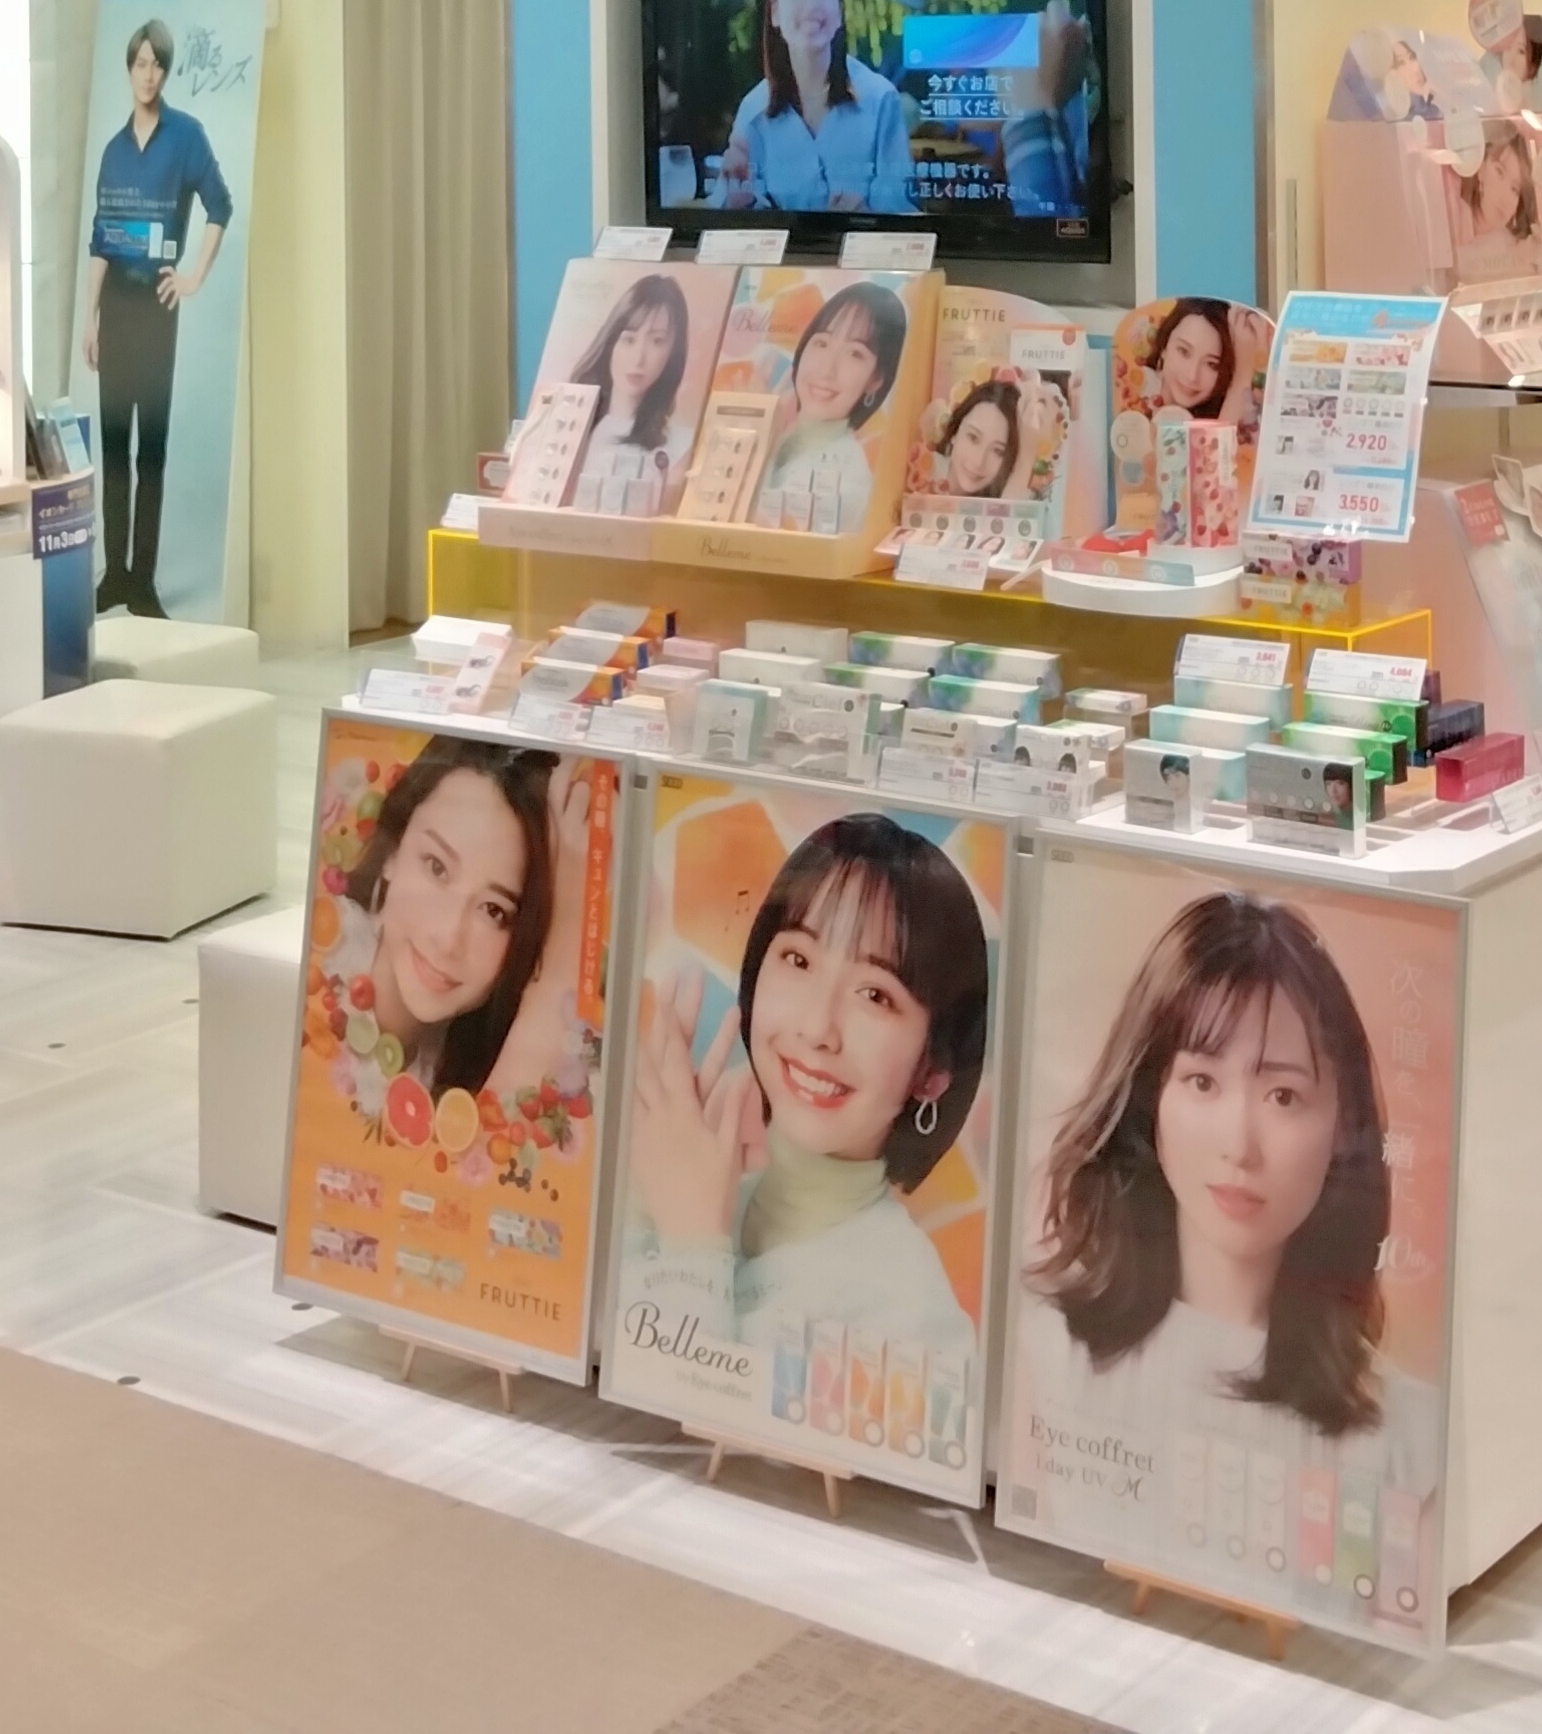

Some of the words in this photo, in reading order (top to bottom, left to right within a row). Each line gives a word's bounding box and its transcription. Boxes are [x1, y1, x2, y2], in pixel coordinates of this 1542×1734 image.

[927, 74, 1014, 93] 今すぐお店で
[941, 307, 1006, 323] FRUTTIE
[698, 536, 752, 562] Belleme
[480, 1282, 563, 1322] FRUTTIE
[624, 1300, 754, 1378] Belleme
[1030, 1414, 1072, 1450] Eye
[1075, 1433, 1156, 1475] coffret
